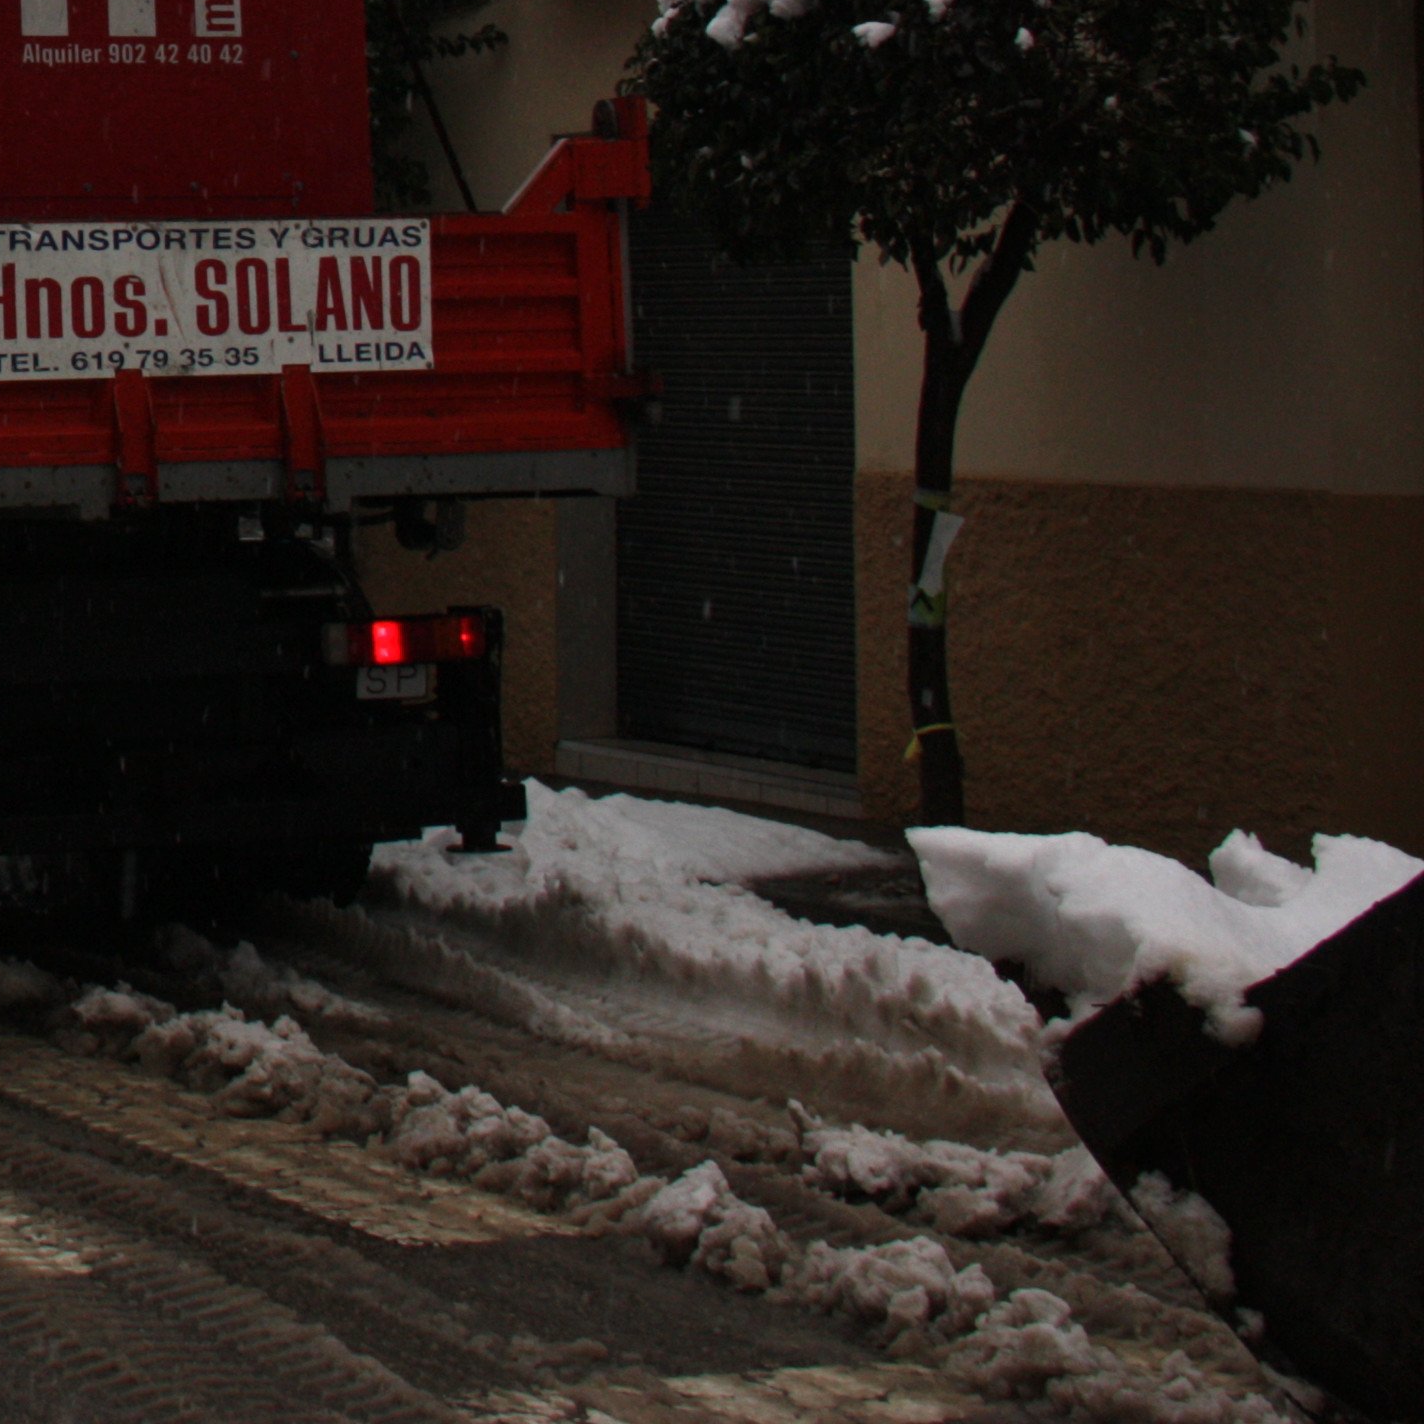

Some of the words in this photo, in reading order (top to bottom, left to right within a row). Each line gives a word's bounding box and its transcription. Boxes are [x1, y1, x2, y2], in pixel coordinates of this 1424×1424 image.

[22, 43, 102, 66] Alquiler
[108, 43, 146, 64] 902
[154, 43, 180, 64] 42
[187, 43, 212, 64] 40
[219, 43, 244, 64] 42
[269, 227, 291, 249] Y
[302, 225, 424, 249] GRUAS
[194, 254, 422, 336] SOLANO
[70, 350, 125, 372] 619
[135, 349, 170, 370] 79
[181, 347, 214, 368] 35
[224, 346, 261, 366] 35
[318, 341, 427, 365] LLEIDA
